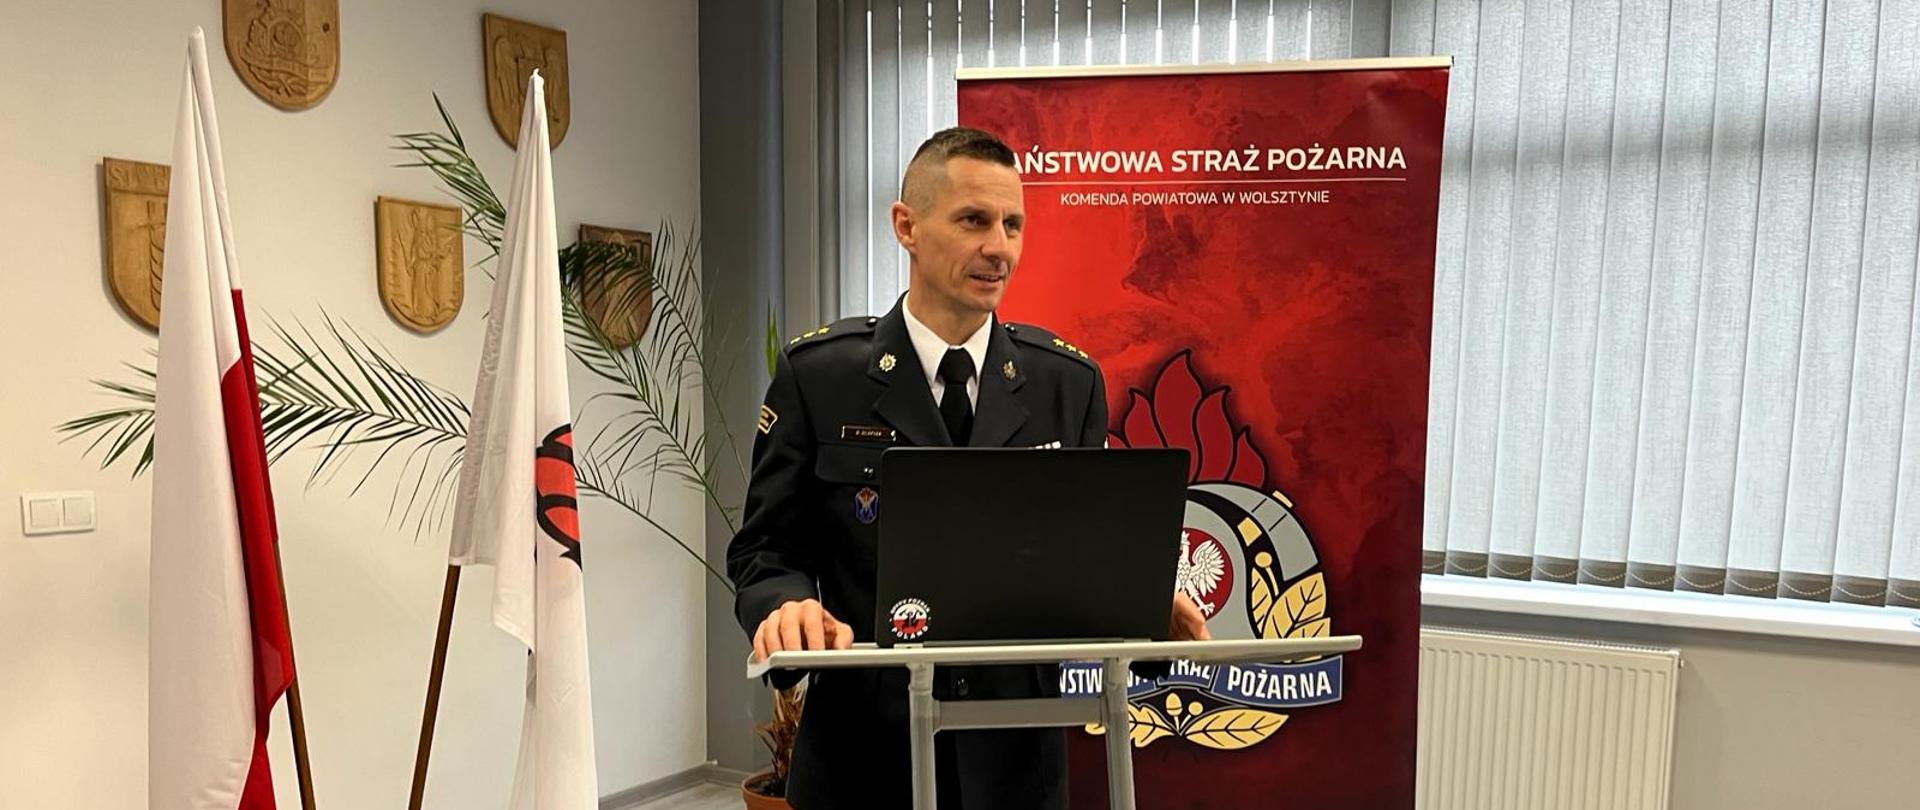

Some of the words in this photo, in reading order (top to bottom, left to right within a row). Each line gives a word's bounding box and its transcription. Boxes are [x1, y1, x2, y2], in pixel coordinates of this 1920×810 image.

[1013, 144, 1163, 174] AŃSTWOWA
[1171, 144, 1260, 173] STRAŻ
[1267, 143, 1407, 171] POŻARNA
[1060, 192, 1128, 206] KOMENDA
[1132, 191, 1217, 206] POWIATOWA
[1222, 191, 1235, 205] W
[1239, 190, 1330, 204] WOLSZTYNIE
[1227, 666, 1333, 700] POŻARNA
